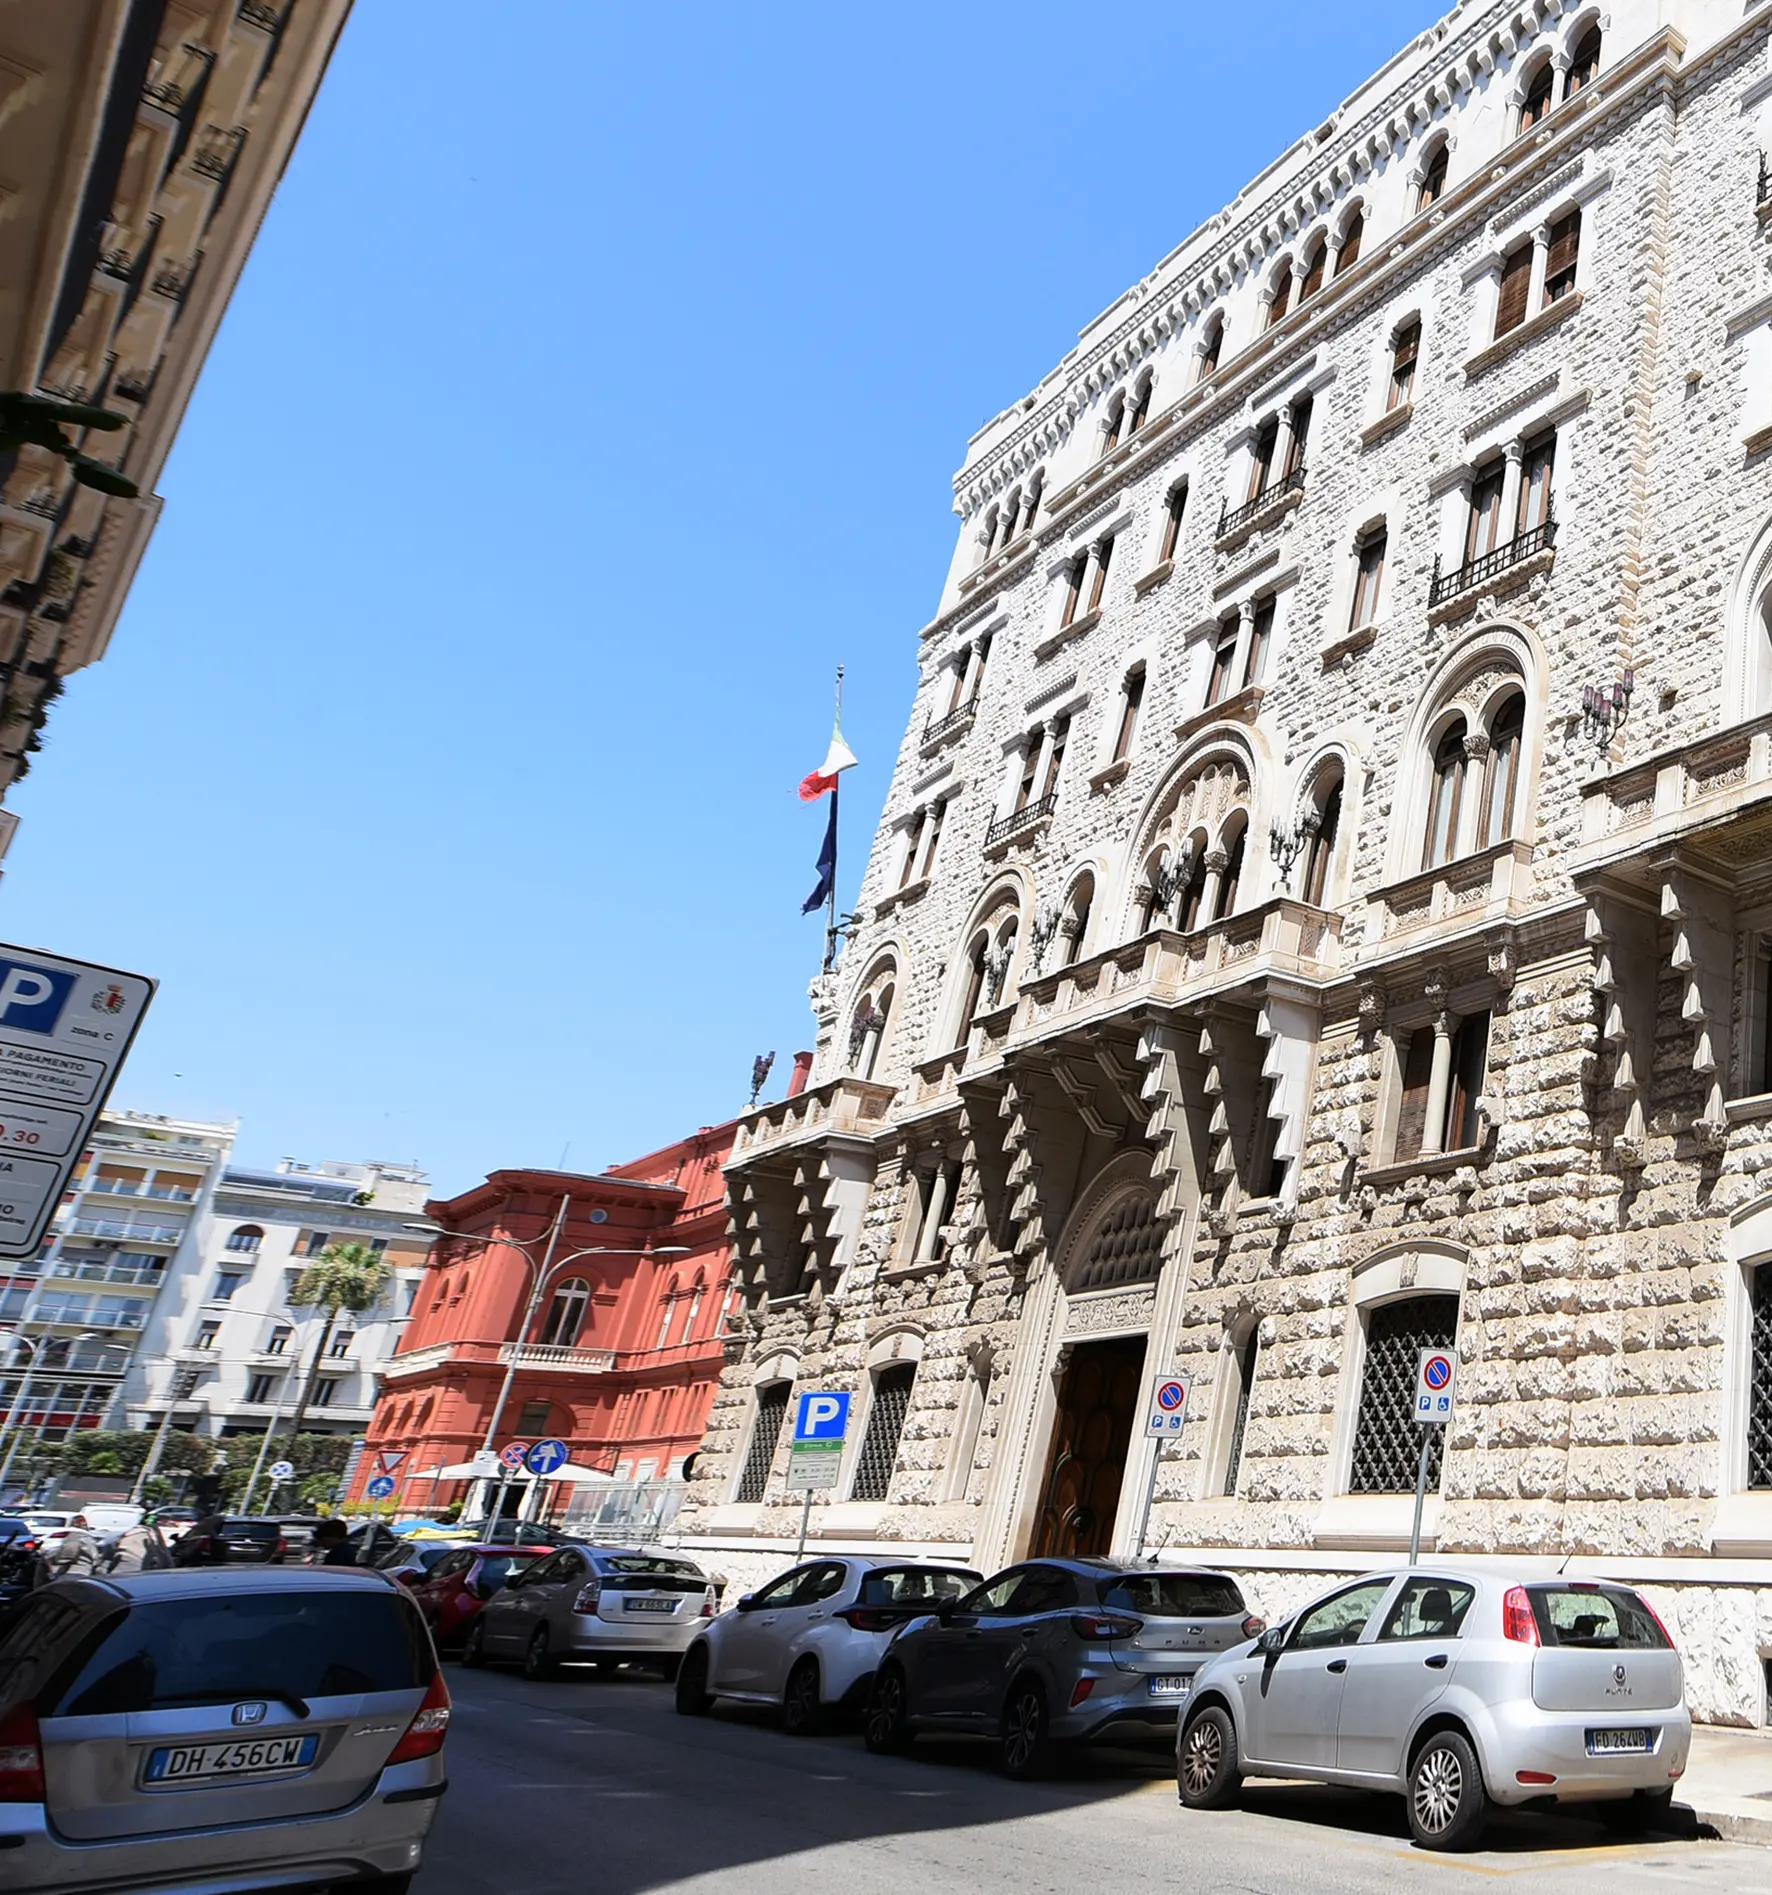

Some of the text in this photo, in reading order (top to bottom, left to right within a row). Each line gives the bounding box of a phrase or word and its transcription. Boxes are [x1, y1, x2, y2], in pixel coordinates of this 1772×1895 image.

[0, 967, 53, 1018] P
[70, 1026, 115, 1041] zona C
[6, 1049, 86, 1072] PAGAMENTO
[0, 1067, 34, 1079] IORNI
[35, 1073, 77, 1087] FERIALI
[804, 1396, 840, 1435] P
[168, 1739, 300, 1775] DH 456CW
